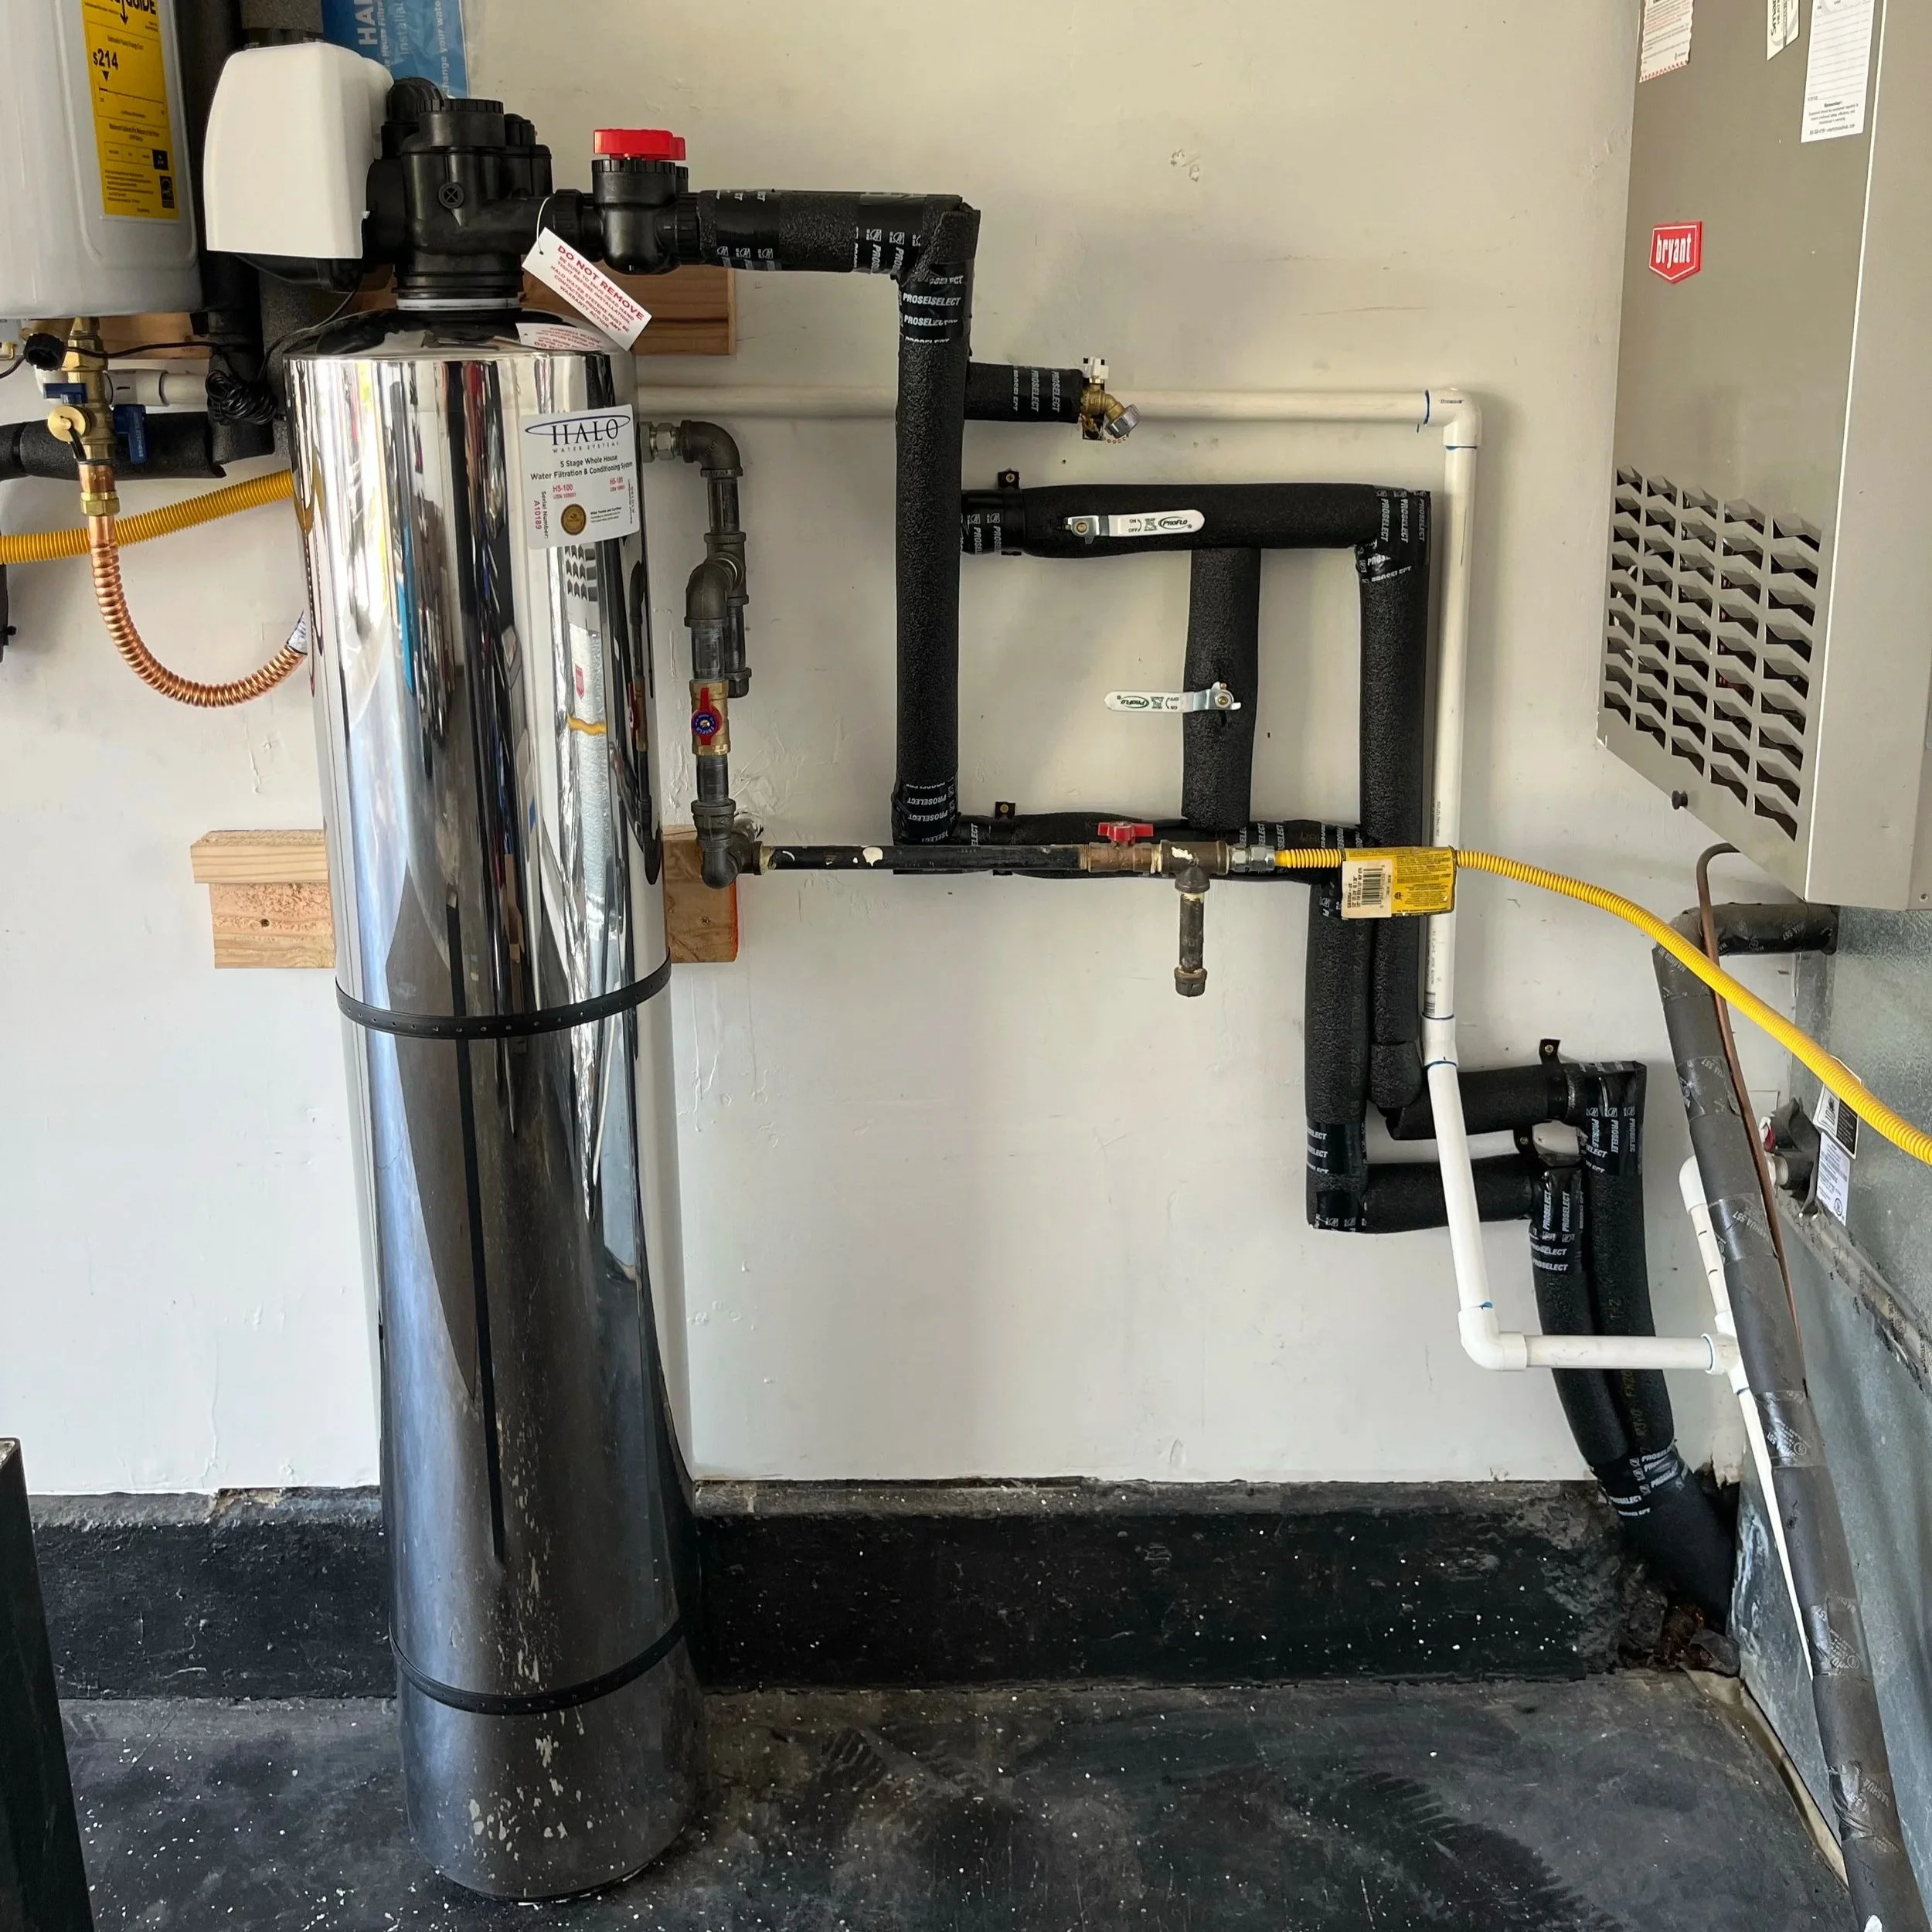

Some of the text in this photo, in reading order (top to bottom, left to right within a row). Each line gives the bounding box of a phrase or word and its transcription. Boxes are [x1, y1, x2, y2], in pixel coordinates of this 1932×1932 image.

[93, 48, 118, 70] $214
[1656, 233, 1692, 269] bryant
[557, 261, 573, 276] TIGHT
[573, 274, 594, 294] BEFORE
[557, 245, 645, 321] DO NOT REMOVE
[560, 256, 634, 321] BE SURE TO SNUG HEAD HAND
[554, 274, 621, 332] CONTACTED PRIOR TO ANY
[560, 286, 589, 310] WARRANTY
[566, 277, 585, 295] WATER
[585, 292, 608, 314] SYSTEMS
[607, 312, 623, 327] MUST
[622, 325, 630, 333] BE
[1031, 369, 1040, 412] PROSELECT
[1051, 370, 1060, 413] PROSELECT
[552, 419, 618, 445] HALO
[554, 469, 583, 478] Filtration
[590, 463, 621, 474] Conditioning
[566, 459, 583, 468] Stage
[1381, 498, 1389, 543] PROSELECT
[1400, 498, 1409, 543] PROSELECT
[907, 794, 947, 805] PROSELECT
[908, 810, 948, 821] PROSELECT
[1562, 1191, 1570, 1232] PROSELECT
[1732, 1211, 1747, 1223] 557
